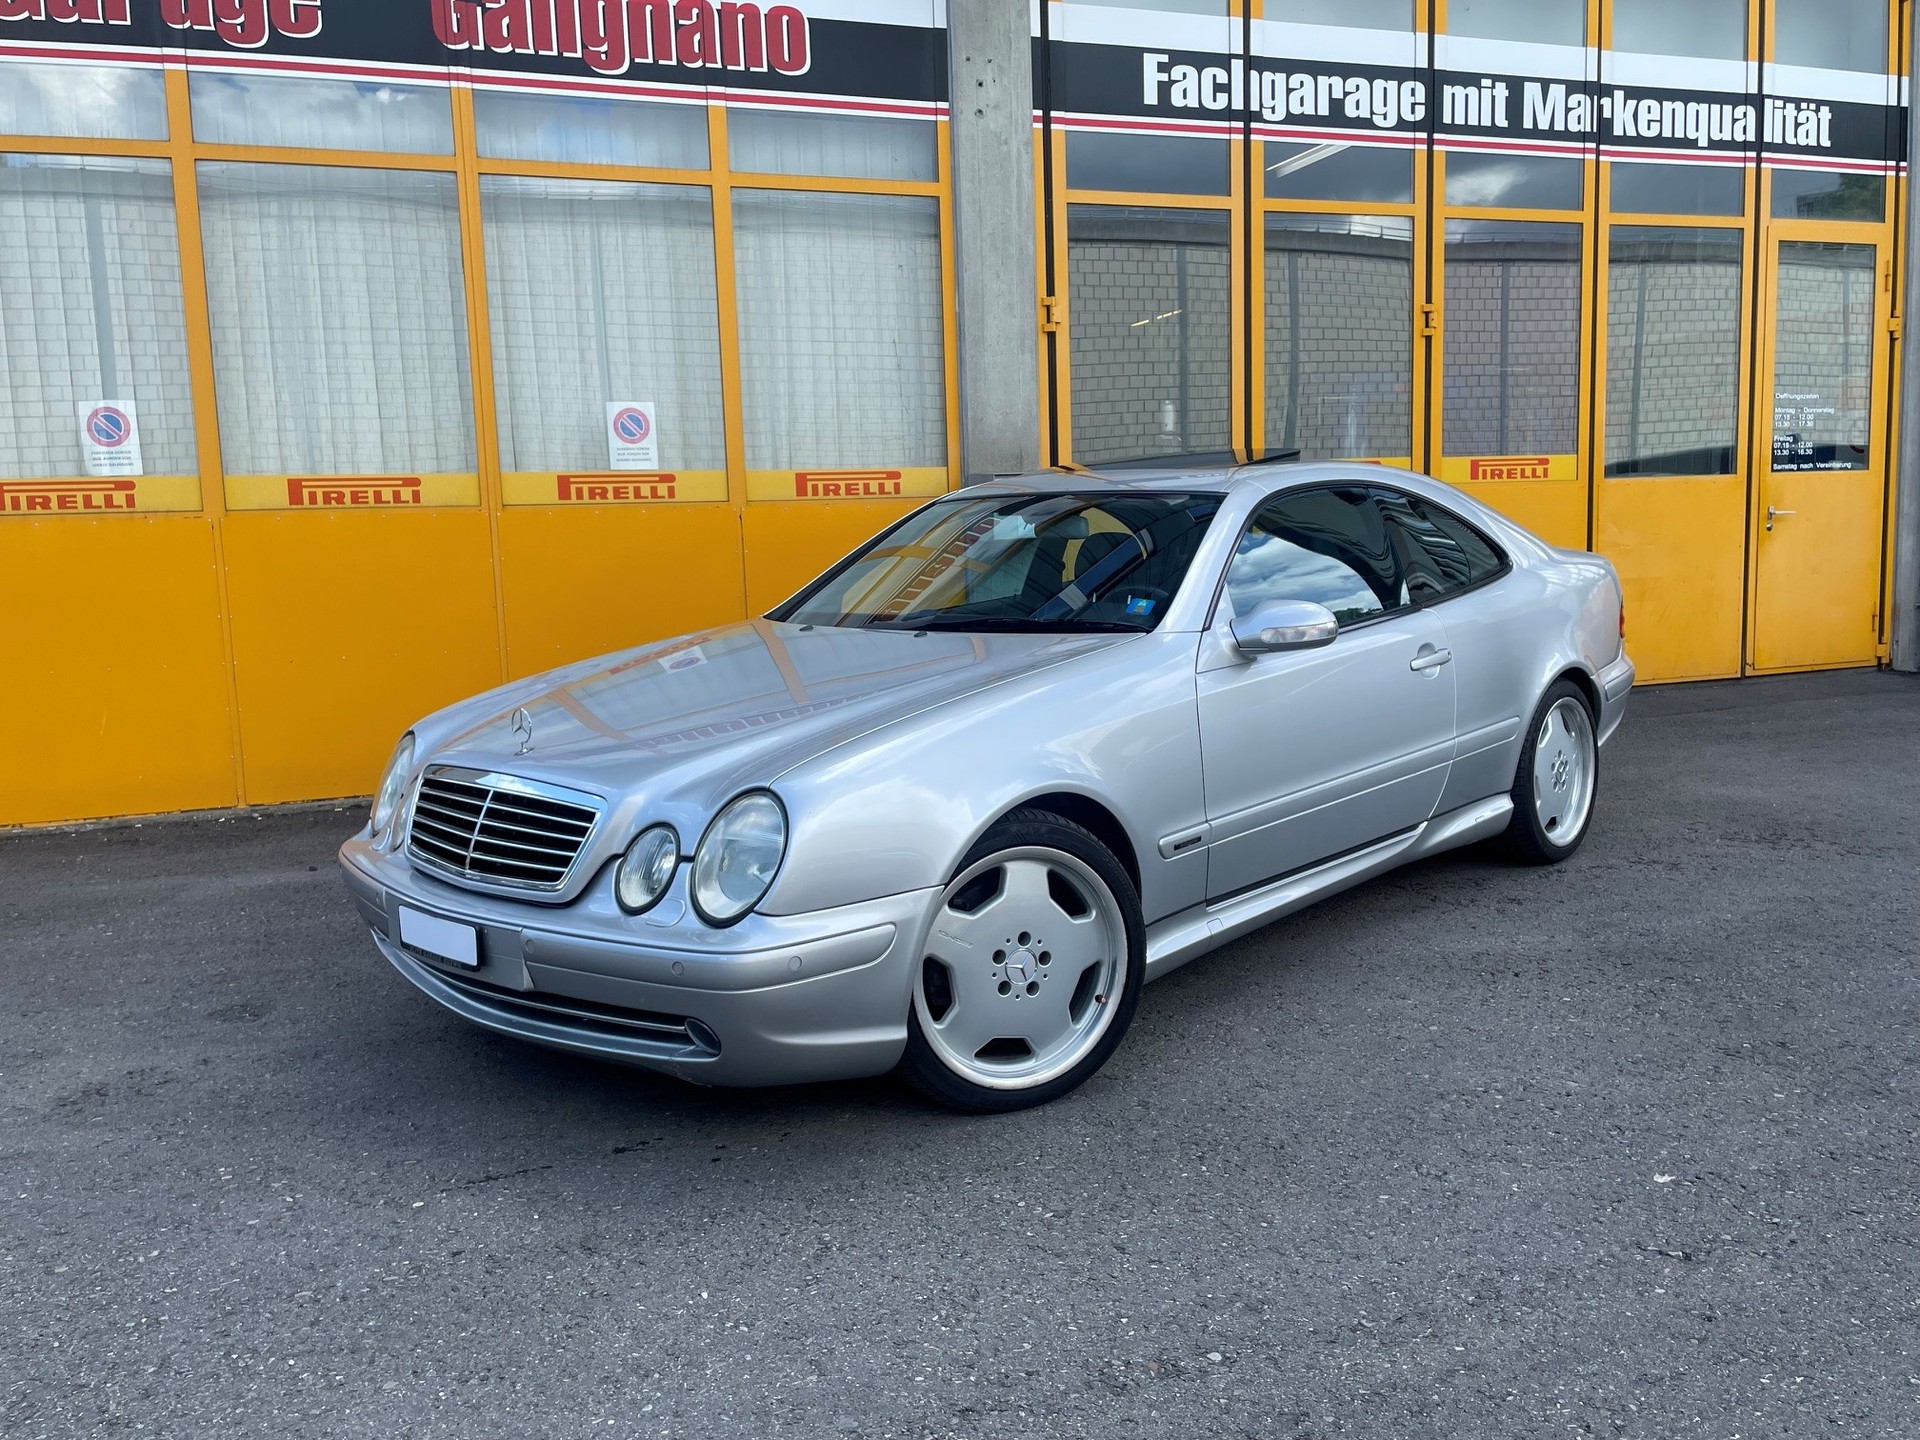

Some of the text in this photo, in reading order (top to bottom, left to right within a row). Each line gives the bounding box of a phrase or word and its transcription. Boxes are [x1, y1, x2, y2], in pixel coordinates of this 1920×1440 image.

[1143, 52, 1832, 148] Fachgarage mit Markenqualität
[1470, 457, 1550, 480] PIRELLI
[286, 477, 422, 506] PIRELLI
[557, 473, 677, 500] PIRELLI
[795, 470, 902, 498] PIRELLI
